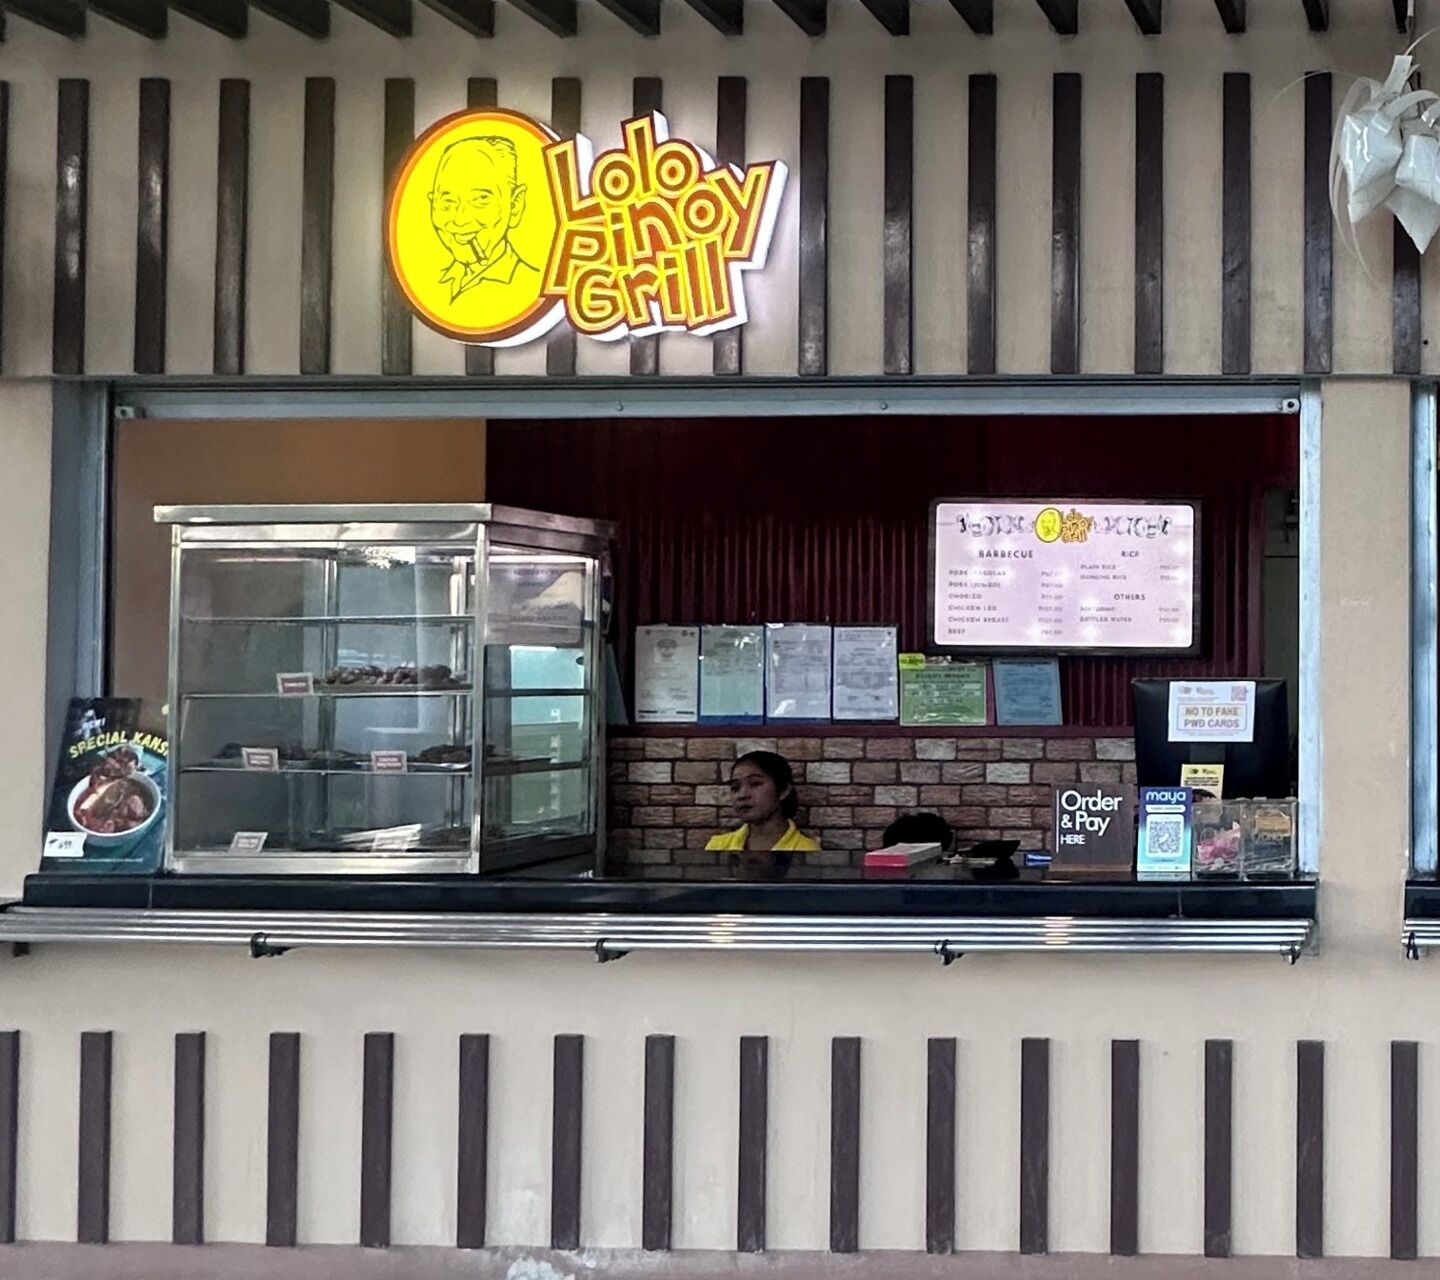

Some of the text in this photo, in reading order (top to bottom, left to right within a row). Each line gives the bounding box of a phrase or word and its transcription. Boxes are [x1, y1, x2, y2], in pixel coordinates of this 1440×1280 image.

[543, 112, 703, 228] Lolo
[544, 162, 777, 296] Pinoy
[568, 238, 736, 333] Grill
[978, 550, 1034, 559] BARBECUE
[1121, 550, 1140, 558] RICE
[1113, 593, 1146, 601] OTHERS
[1185, 707, 1239, 716] NO TO FAKE
[1184, 719, 1240, 728] PWD CARDS
[69, 730, 128, 759] SPECIAL
[1061, 790, 1123, 811] Order
[1145, 791, 1186, 804] maya
[1061, 811, 1111, 836] & Pay
[1060, 834, 1086, 845] HERE
